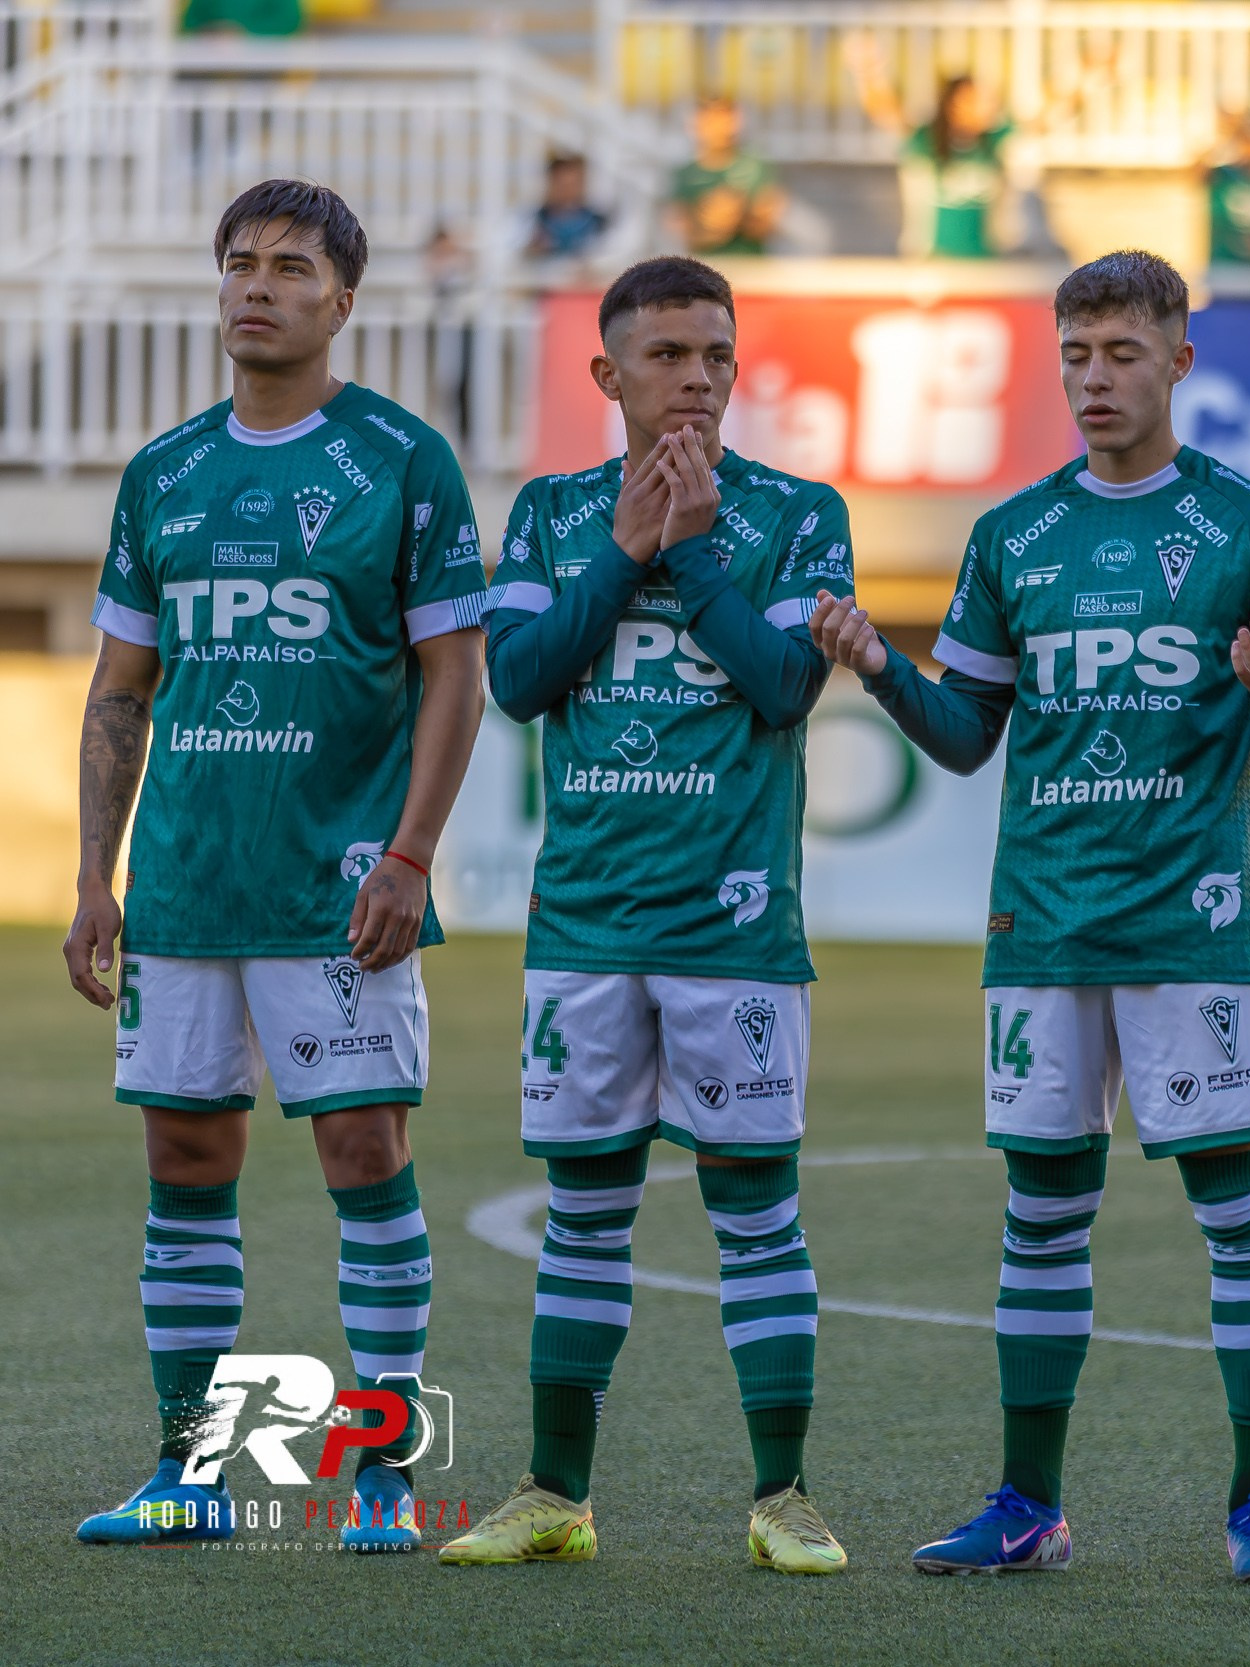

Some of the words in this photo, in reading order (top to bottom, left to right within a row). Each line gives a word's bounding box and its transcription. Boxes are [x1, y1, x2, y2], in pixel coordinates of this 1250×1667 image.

[157, 442, 216, 493] Biozen
[324, 438, 374, 496] Biozen
[240, 501, 268, 513] 1892
[550, 494, 612, 540] Biozen
[719, 502, 765, 548] iozen
[1005, 500, 1070, 558] Biozen
[1175, 493, 1229, 548] Biozen
[218, 546, 244, 555] MALL
[218, 554, 247, 563] PASEO
[249, 554, 273, 564] ROSS
[1100, 550, 1129, 564] 1892
[555, 564, 588, 578] KS
[163, 578, 331, 641] TPS
[651, 599, 677, 610] ROSS
[1079, 604, 1110, 614] PASEO
[1112, 602, 1137, 612] ROSS
[1080, 596, 1106, 606] MALL
[183, 644, 316, 664] VALPARAÍSO
[577, 622, 731, 687] PS
[1026, 625, 1200, 696] TPS
[578, 687, 718, 706] VALPARAÍSO
[1039, 690, 1182, 714] VALPARAÍSO
[170, 721, 315, 753] Latamwin
[563, 762, 715, 796] Latamwin
[1030, 768, 1184, 807] Latamwin
[329, 1034, 393, 1050] FOTON
[989, 1002, 1035, 1079] 14
[330, 1048, 365, 1057] CAMIONES
[737, 1091, 775, 1100] CAMIONES
[1208, 1080, 1244, 1093] CAMIONES
